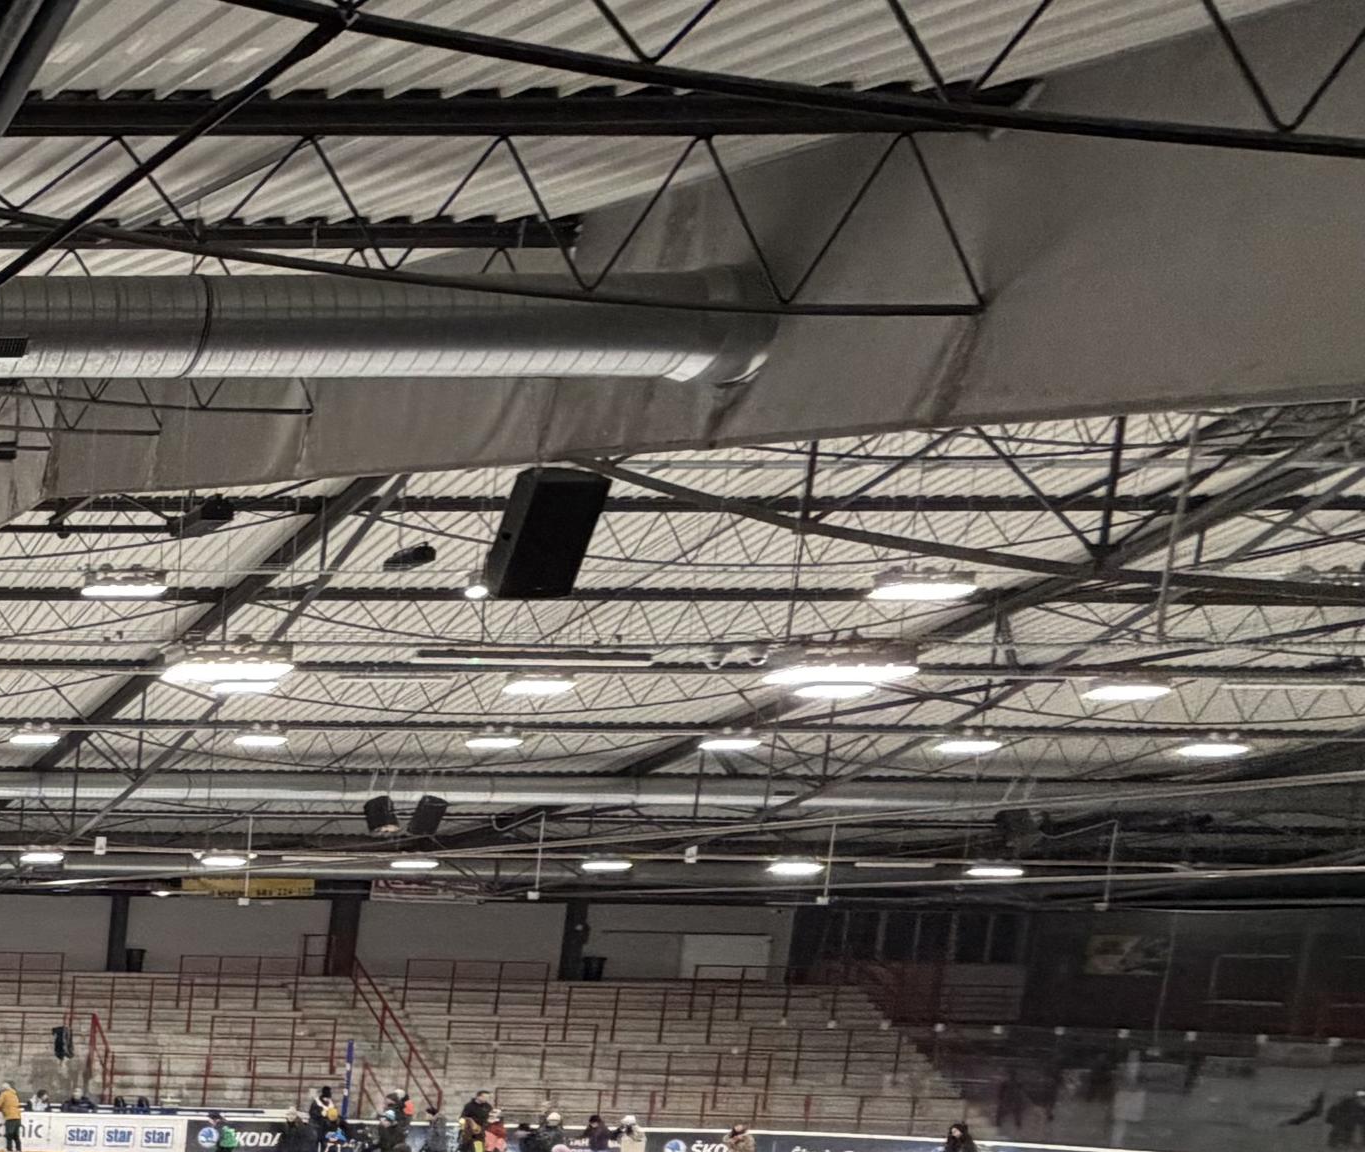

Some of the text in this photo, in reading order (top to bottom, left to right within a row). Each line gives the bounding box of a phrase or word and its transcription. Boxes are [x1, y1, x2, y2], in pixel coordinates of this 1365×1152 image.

[68, 1127, 94, 1142] star
[105, 1128, 133, 1143] star
[144, 1129, 171, 1144] star
